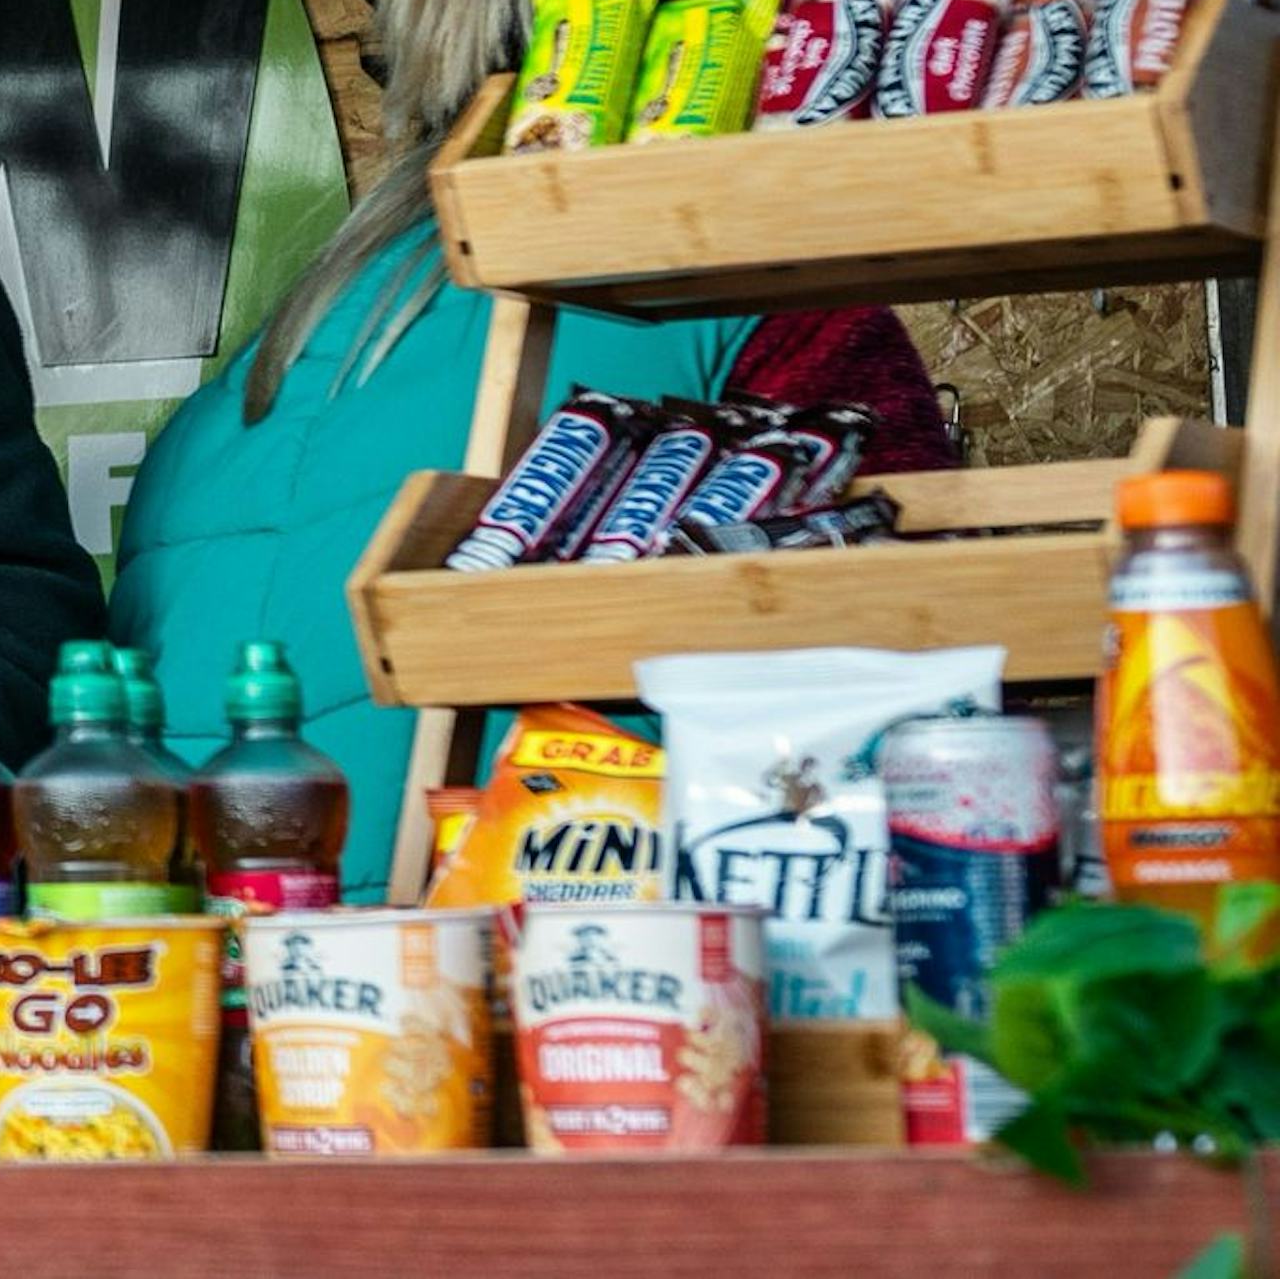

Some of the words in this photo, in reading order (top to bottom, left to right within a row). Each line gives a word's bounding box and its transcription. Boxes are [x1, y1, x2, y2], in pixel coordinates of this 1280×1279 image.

[490, 413, 604, 533] SNICKERS
[610, 431, 706, 540] SNICKERS
[679, 454, 777, 528] SNICK
[541, 738, 656, 768] GRAB
[673, 847, 894, 928] KETTL
[252, 977, 384, 1019] QUAKER
[526, 970, 683, 1012] QUAKER
[13, 993, 111, 1034] GO
[539, 1043, 670, 1083] ORIGINAL
